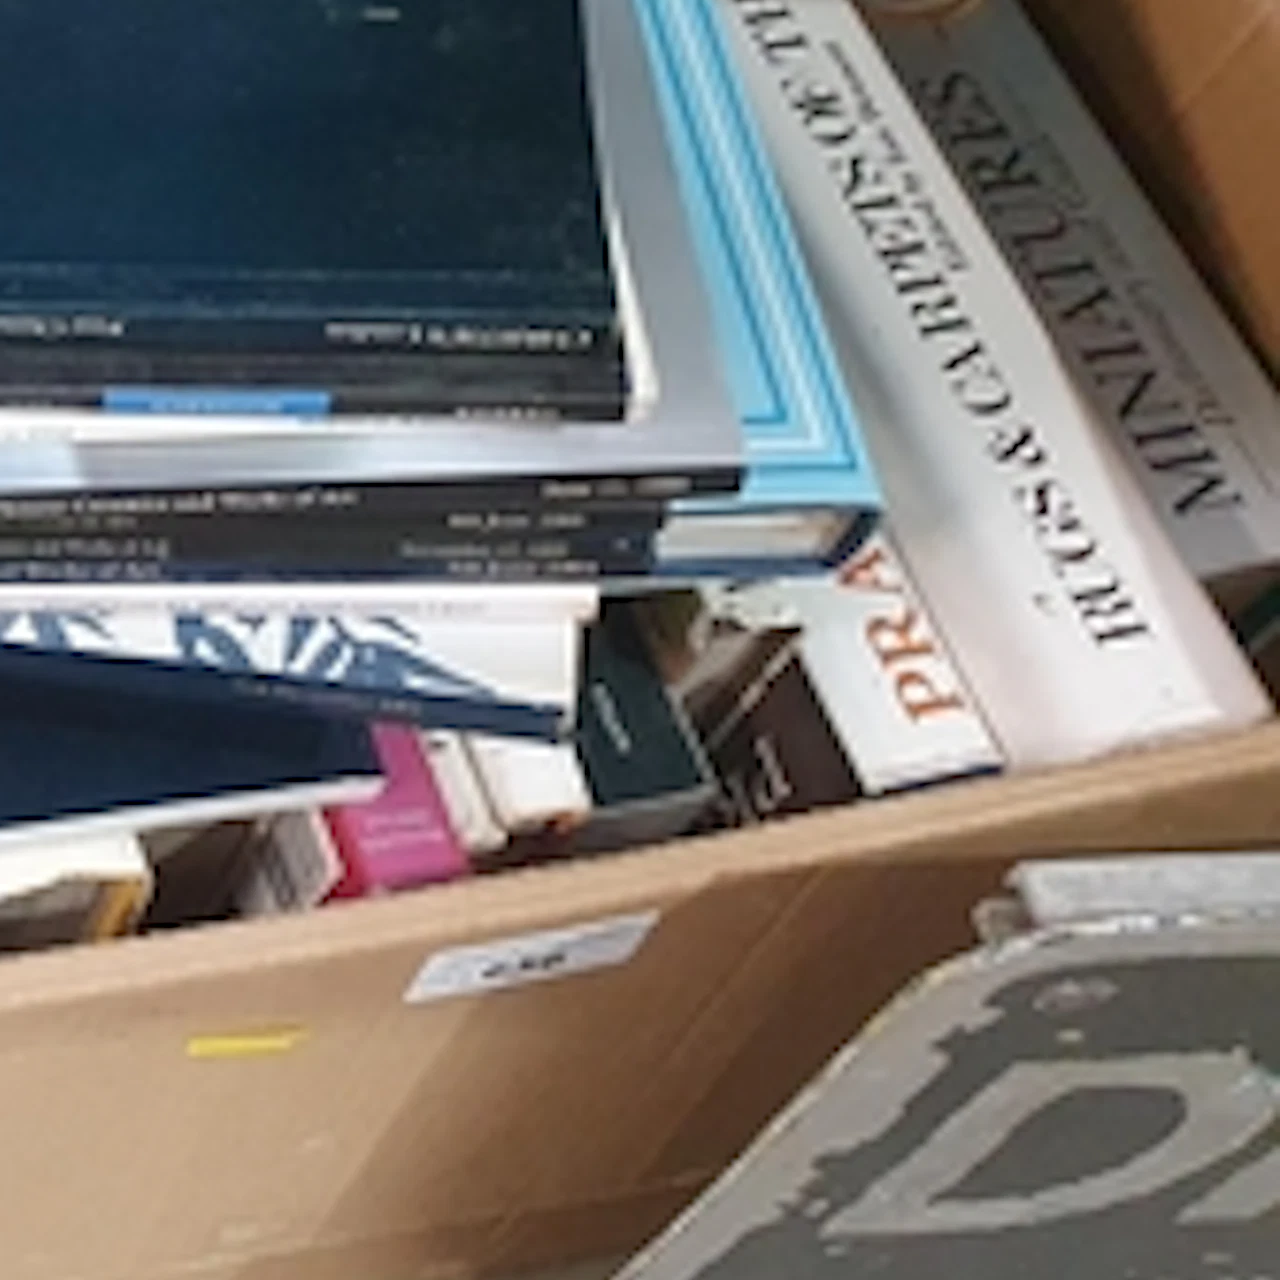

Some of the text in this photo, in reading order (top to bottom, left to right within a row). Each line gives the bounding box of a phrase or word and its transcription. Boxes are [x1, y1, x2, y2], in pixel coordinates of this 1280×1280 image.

[782, 72, 852, 172] OF
[837, 154, 1014, 420] CARPETS
[920, 68, 1244, 517] MINIATURES
[986, 418, 1044, 470] &
[1010, 475, 1152, 650] RUGS
